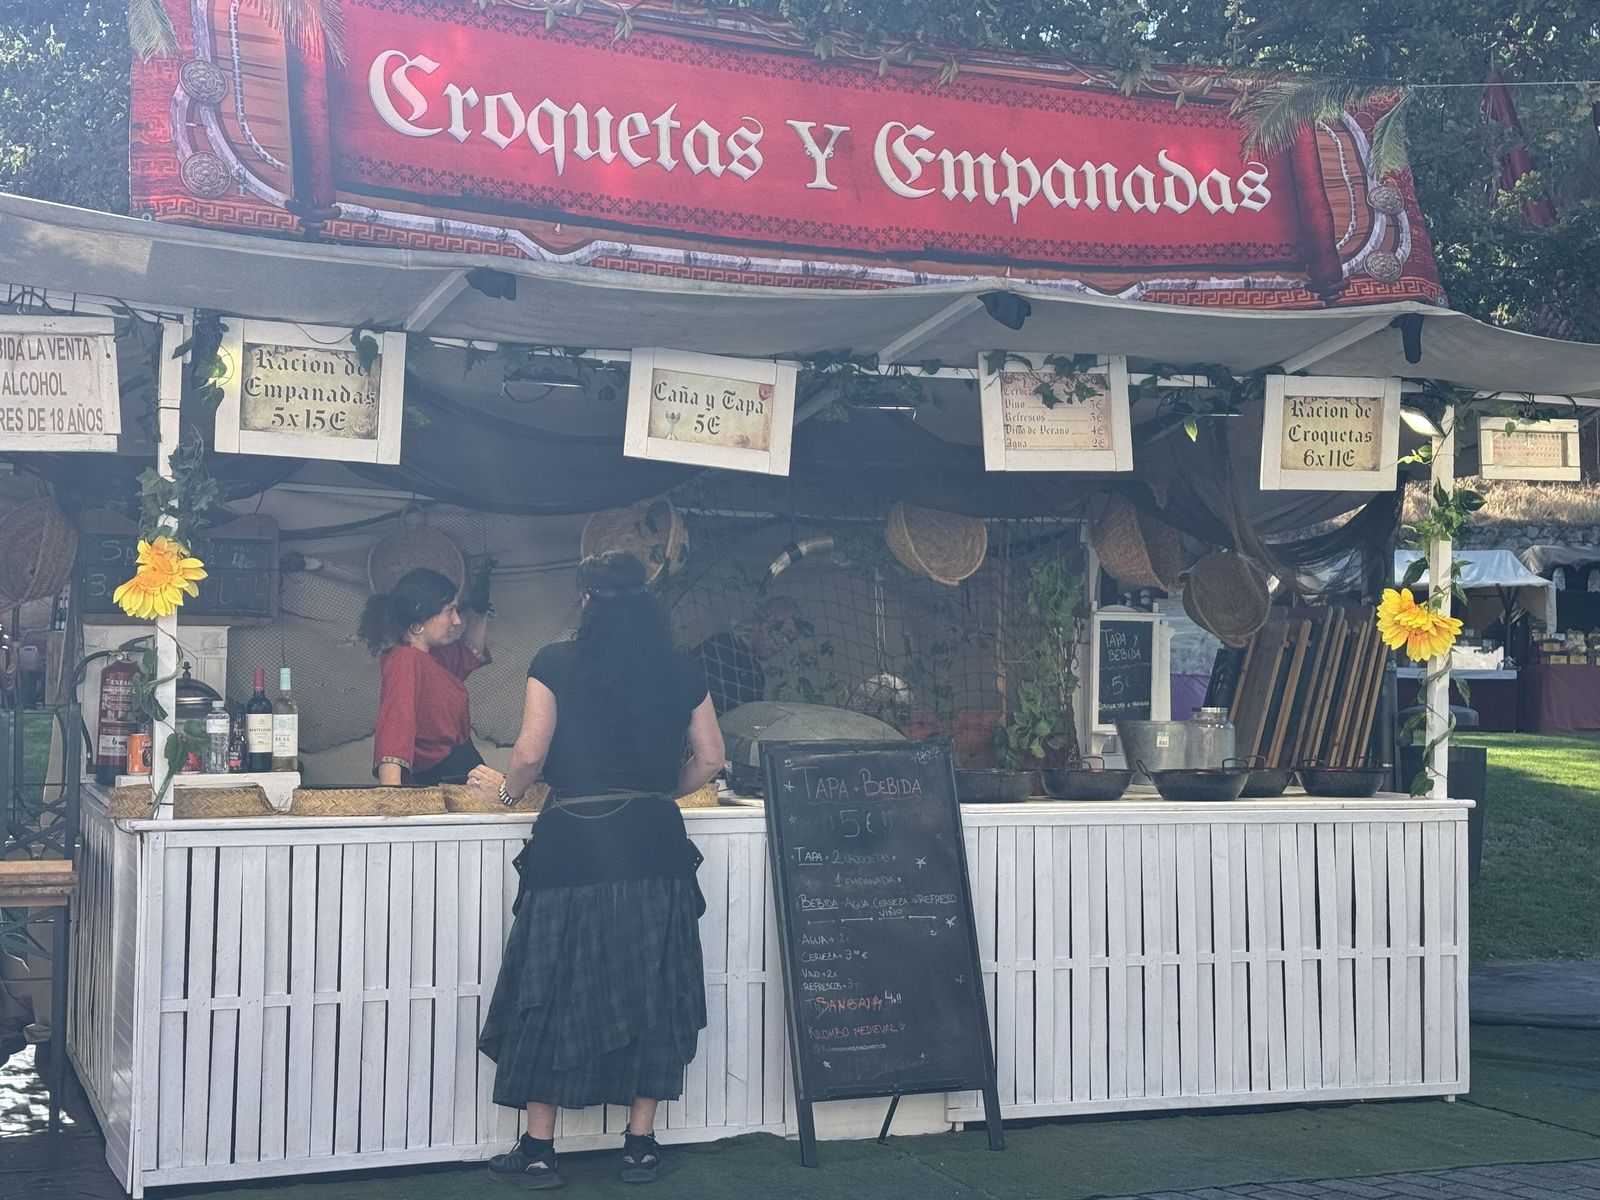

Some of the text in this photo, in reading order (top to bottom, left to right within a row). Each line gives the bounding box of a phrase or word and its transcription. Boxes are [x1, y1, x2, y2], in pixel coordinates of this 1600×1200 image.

[368, 49, 1272, 224] Croquetas Y Empanadas
[27, 338, 47, 361] LA
[47, 337, 92, 361] VENTA
[256, 348, 336, 375] Racion
[1, 371, 68, 396] ALCOHOL
[244, 376, 376, 406] Empanadas
[654, 381, 765, 417] Caña y Tapa
[1004, 400, 1025, 409] Vino
[1291, 400, 1372, 419] Racion de
[27, 407, 46, 431] DE
[50, 407, 65, 432] 18
[67, 402, 104, 432] AÑOS
[1004, 412, 1046, 422] Refrescos
[1028, 426, 1037, 435] de
[1040, 424, 1070, 435] Verano
[1288, 424, 1372, 446] Croquetas
[1005, 438, 1027, 450] Agua
[792, 766, 850, 800] TAPA
[859, 768, 922, 797] BEBIDA
[794, 846, 823, 863] TAPA
[832, 849, 844, 865] 2
[799, 894, 839, 909] BEBIDA
[801, 933, 829, 945] AGUA
